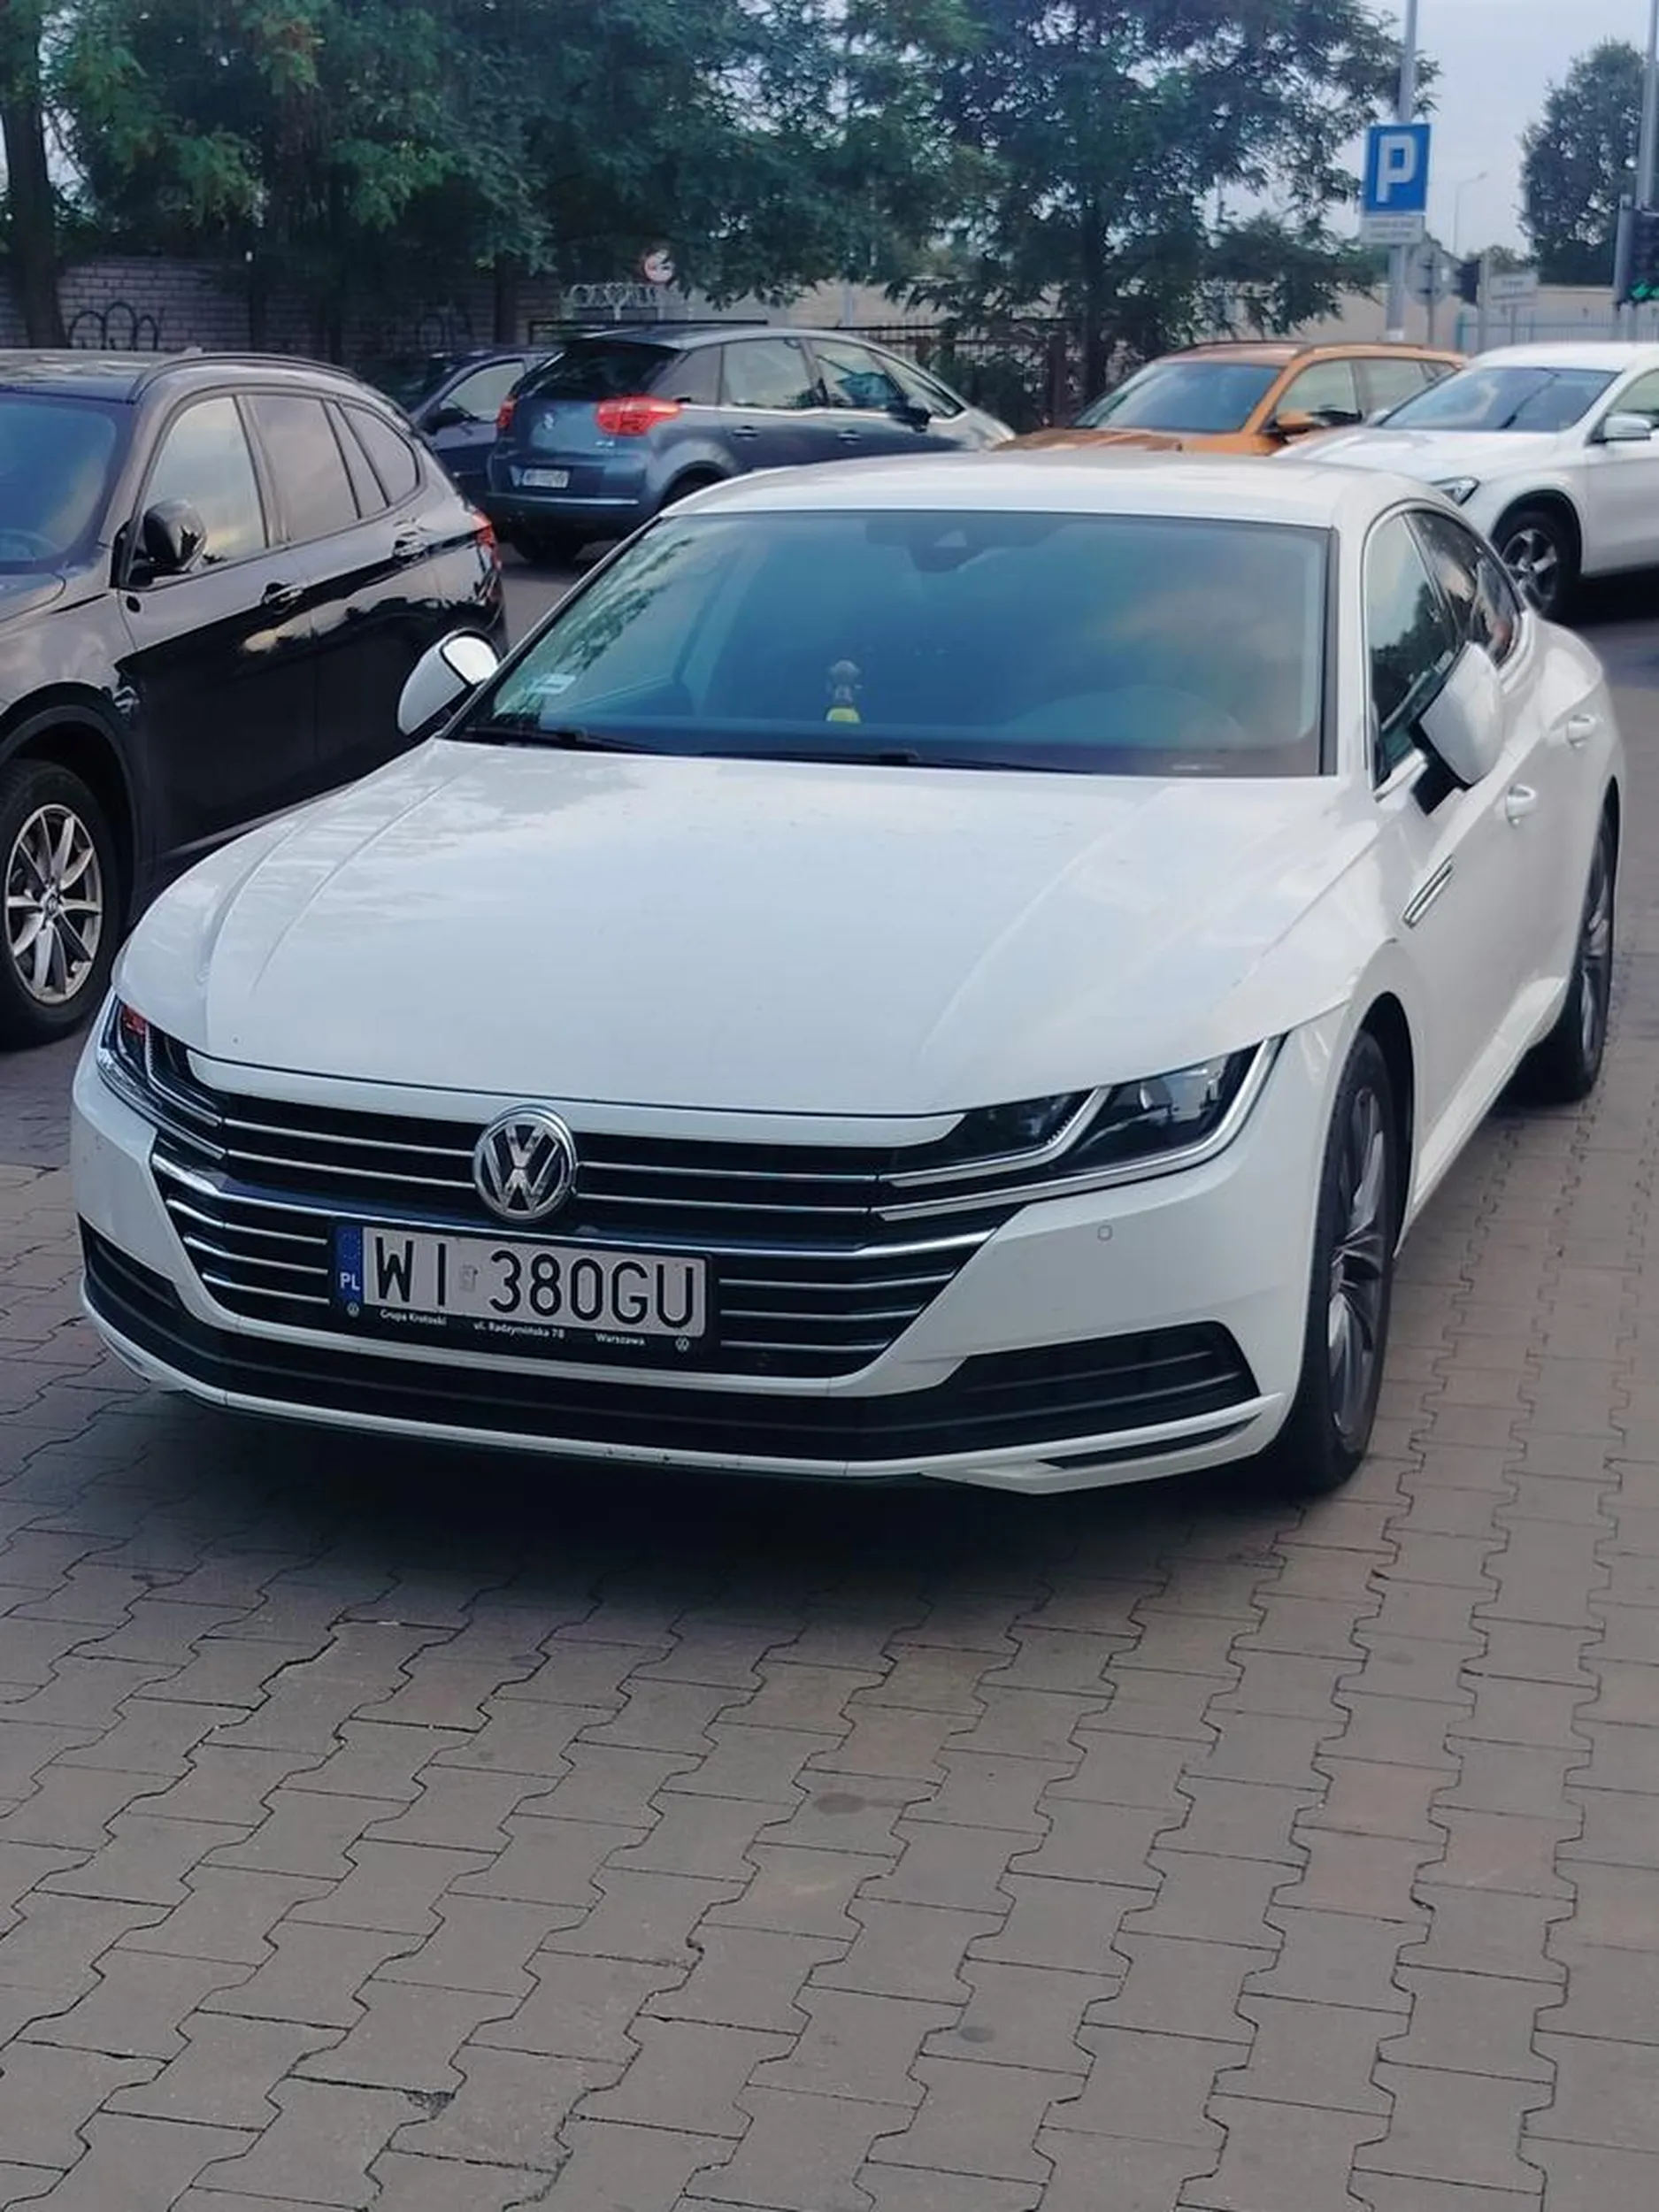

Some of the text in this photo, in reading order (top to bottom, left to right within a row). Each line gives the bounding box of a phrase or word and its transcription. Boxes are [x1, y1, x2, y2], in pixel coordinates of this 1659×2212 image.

[1375, 134, 1416, 204] P
[339, 1271, 361, 1292] PL
[488, 1248, 694, 1329] 380GU
[595, 1332, 646, 1346] Warszawa
